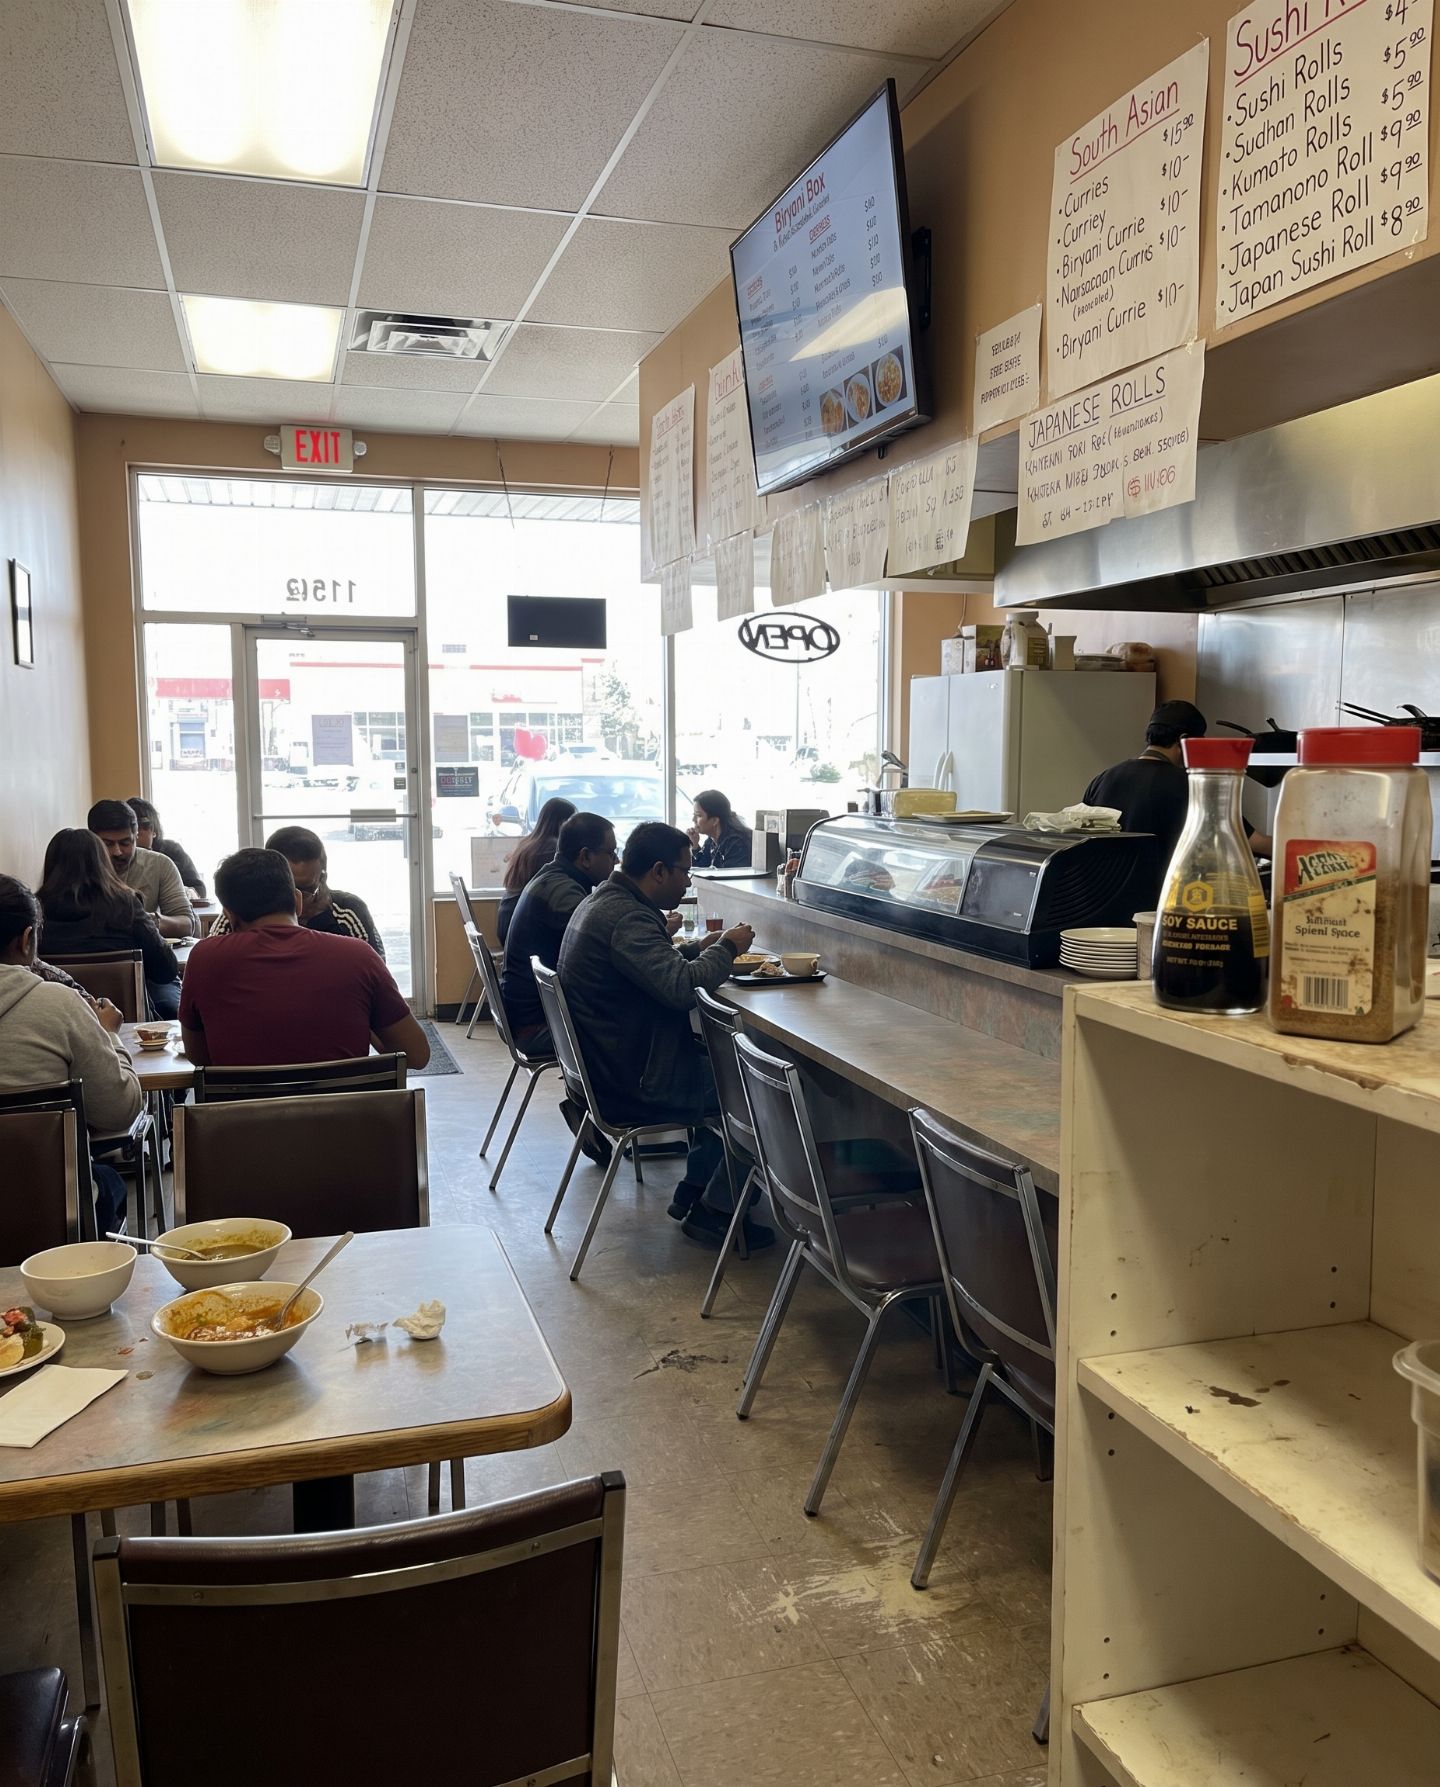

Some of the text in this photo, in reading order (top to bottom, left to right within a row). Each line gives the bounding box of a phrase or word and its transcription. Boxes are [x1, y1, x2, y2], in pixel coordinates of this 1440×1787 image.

[1234, 0, 1308, 77] Sushi
[1233, 113, 1295, 163] Sudhan
[1304, 75, 1350, 122] Rolls
[1235, 73, 1285, 126] Sushi
[1295, 38, 1343, 89] Rolls
[1070, 81, 1178, 175] South Asian
[1232, 146, 1298, 200] Kumoto
[1306, 112, 1352, 157] Rolls
[806, 172, 826, 202] Box
[1064, 176, 1109, 218] Curries
[1229, 169, 1328, 235] Tamanono
[1337, 132, 1373, 179] Roll
[1063, 209, 1106, 247] Curriey
[1063, 238, 1102, 279] Biryani
[1107, 217, 1145, 251] Currie
[1228, 269, 1283, 312] Japan
[1291, 239, 1335, 281] Sushi
[1342, 215, 1374, 258] Roll
[1229, 210, 1322, 276] Japanese
[1332, 175, 1369, 222] Roll
[1062, 319, 1102, 359] Biryani
[1107, 300, 1146, 333] Currie
[295, 429, 340, 464] EXIT
[1029, 393, 1101, 448] JAPANESE
[1112, 366, 1166, 412] ROLLS
[1161, 915, 1238, 931] SOY SAUCE
